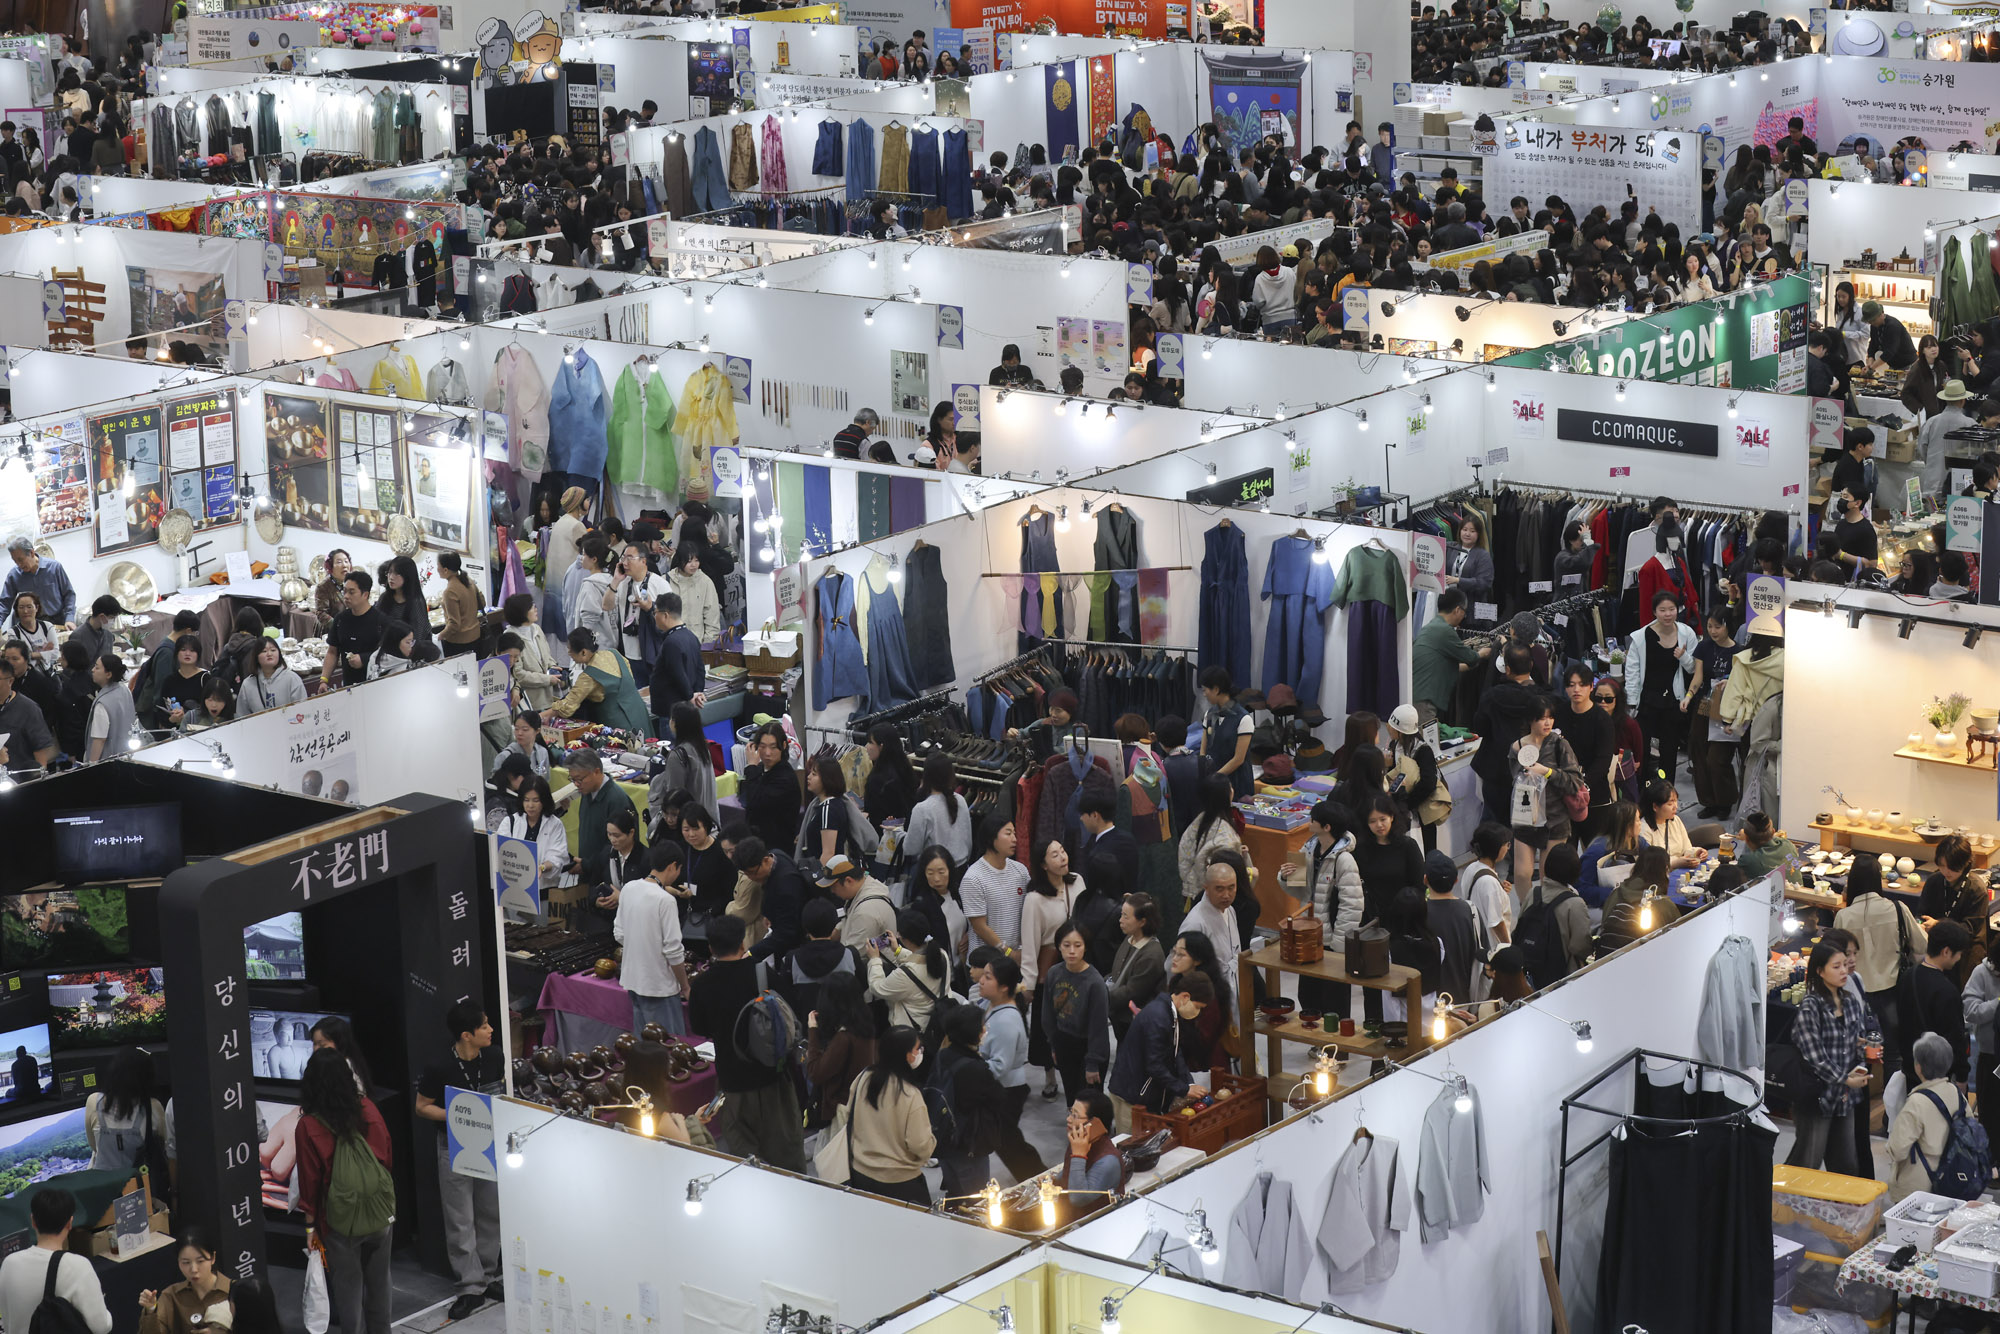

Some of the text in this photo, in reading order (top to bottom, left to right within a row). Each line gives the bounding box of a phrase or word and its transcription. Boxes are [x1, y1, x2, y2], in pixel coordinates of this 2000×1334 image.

[982, 7, 996, 16] BTN
[982, 13, 1022, 30] BTN 투어
[1096, 10, 1147, 26] BTN 투어
[199, 50, 231, 60] 아름다운동행
[1922, 73, 1955, 88] 승가원
[769, 84, 787, 93] 이곳에
[788, 85, 812, 94] 당도하신
[1910, 103, 1927, 112] 행복한
[1929, 105, 1945, 115] 세상,
[1948, 104, 1961, 113] 함께
[1526, 127, 1563, 150] 내가
[1571, 130, 1627, 155] 부처가
[1475, 145, 1494, 154] 계산대
[1514, 152, 1527, 161] 모든
[1548, 154, 1567, 163] 부처가
[1568, 155, 1575, 165] 될
[1577, 156, 1583, 164] 수
[1584, 157, 1597, 166] 있는
[1617, 160, 1631, 169] 지닌
[1632, 161, 1667, 171] 존재입니다!
[176, 399, 221, 417] 김천방짜유
[1520, 406, 1537, 418] SALE
[64, 422, 76, 430] KBS
[102, 415, 152, 434] 명인 이 운 형
[1592, 419, 1677, 445] CCOMAQUE
[1744, 431, 1761, 443] SALE
[1753, 592, 1781, 604] 도예명장
[1753, 602, 1774, 611] 영산요
[482, 677, 494, 688] 영천
[289, 731, 351, 764] 참선목공예
[123, 834, 144, 844] 아니다
[289, 828, 390, 901] 不老門
[213, 975, 245, 1112] 당신의
